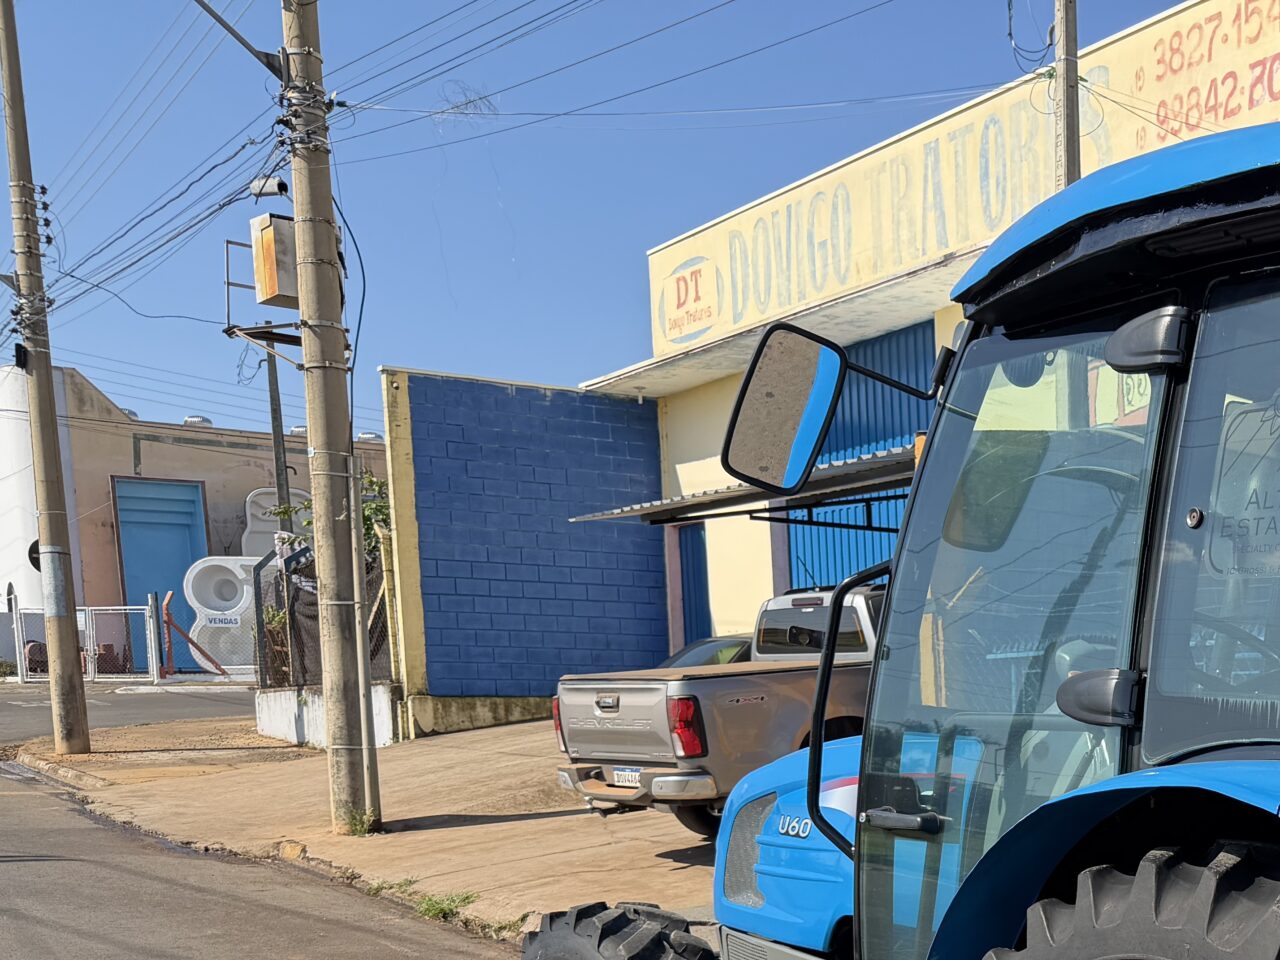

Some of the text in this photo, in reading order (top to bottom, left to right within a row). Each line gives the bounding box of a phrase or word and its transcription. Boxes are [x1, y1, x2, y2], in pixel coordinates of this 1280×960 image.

[729, 181, 852, 325] DOVIGO
[676, 269, 702, 310] DT
[1233, 543, 1273, 554] SPECIALTY
[208, 617, 239, 626] VENDAS
[569, 718, 652, 730] CHEVROLET
[779, 814, 812, 838] U60
